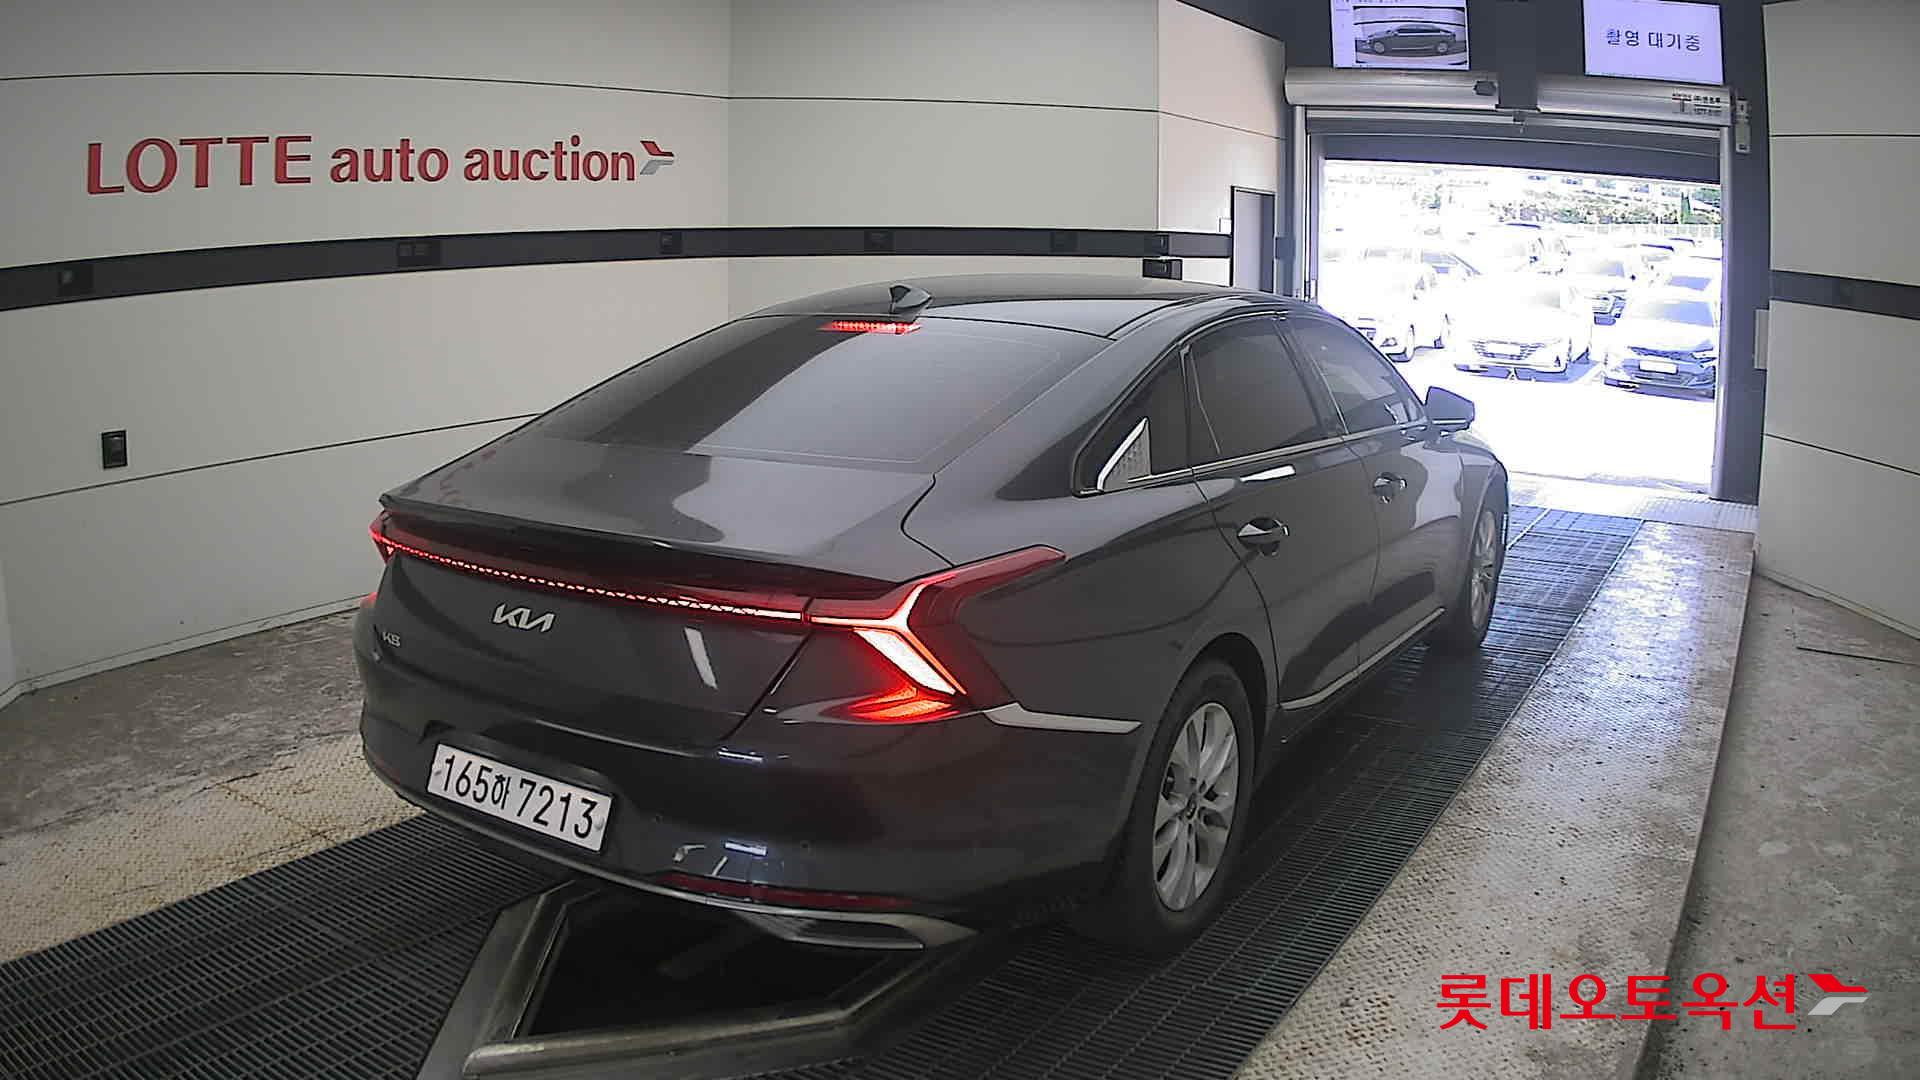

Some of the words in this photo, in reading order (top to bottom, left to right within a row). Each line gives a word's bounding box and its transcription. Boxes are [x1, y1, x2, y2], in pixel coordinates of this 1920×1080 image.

[1647, 32, 1700, 51] 대기중
[87, 135, 312, 194] LOTTE
[330, 138, 449, 182] auto
[463, 135, 637, 182] auction
[443, 755, 511, 809] 165하
[516, 779, 598, 839] 7213
